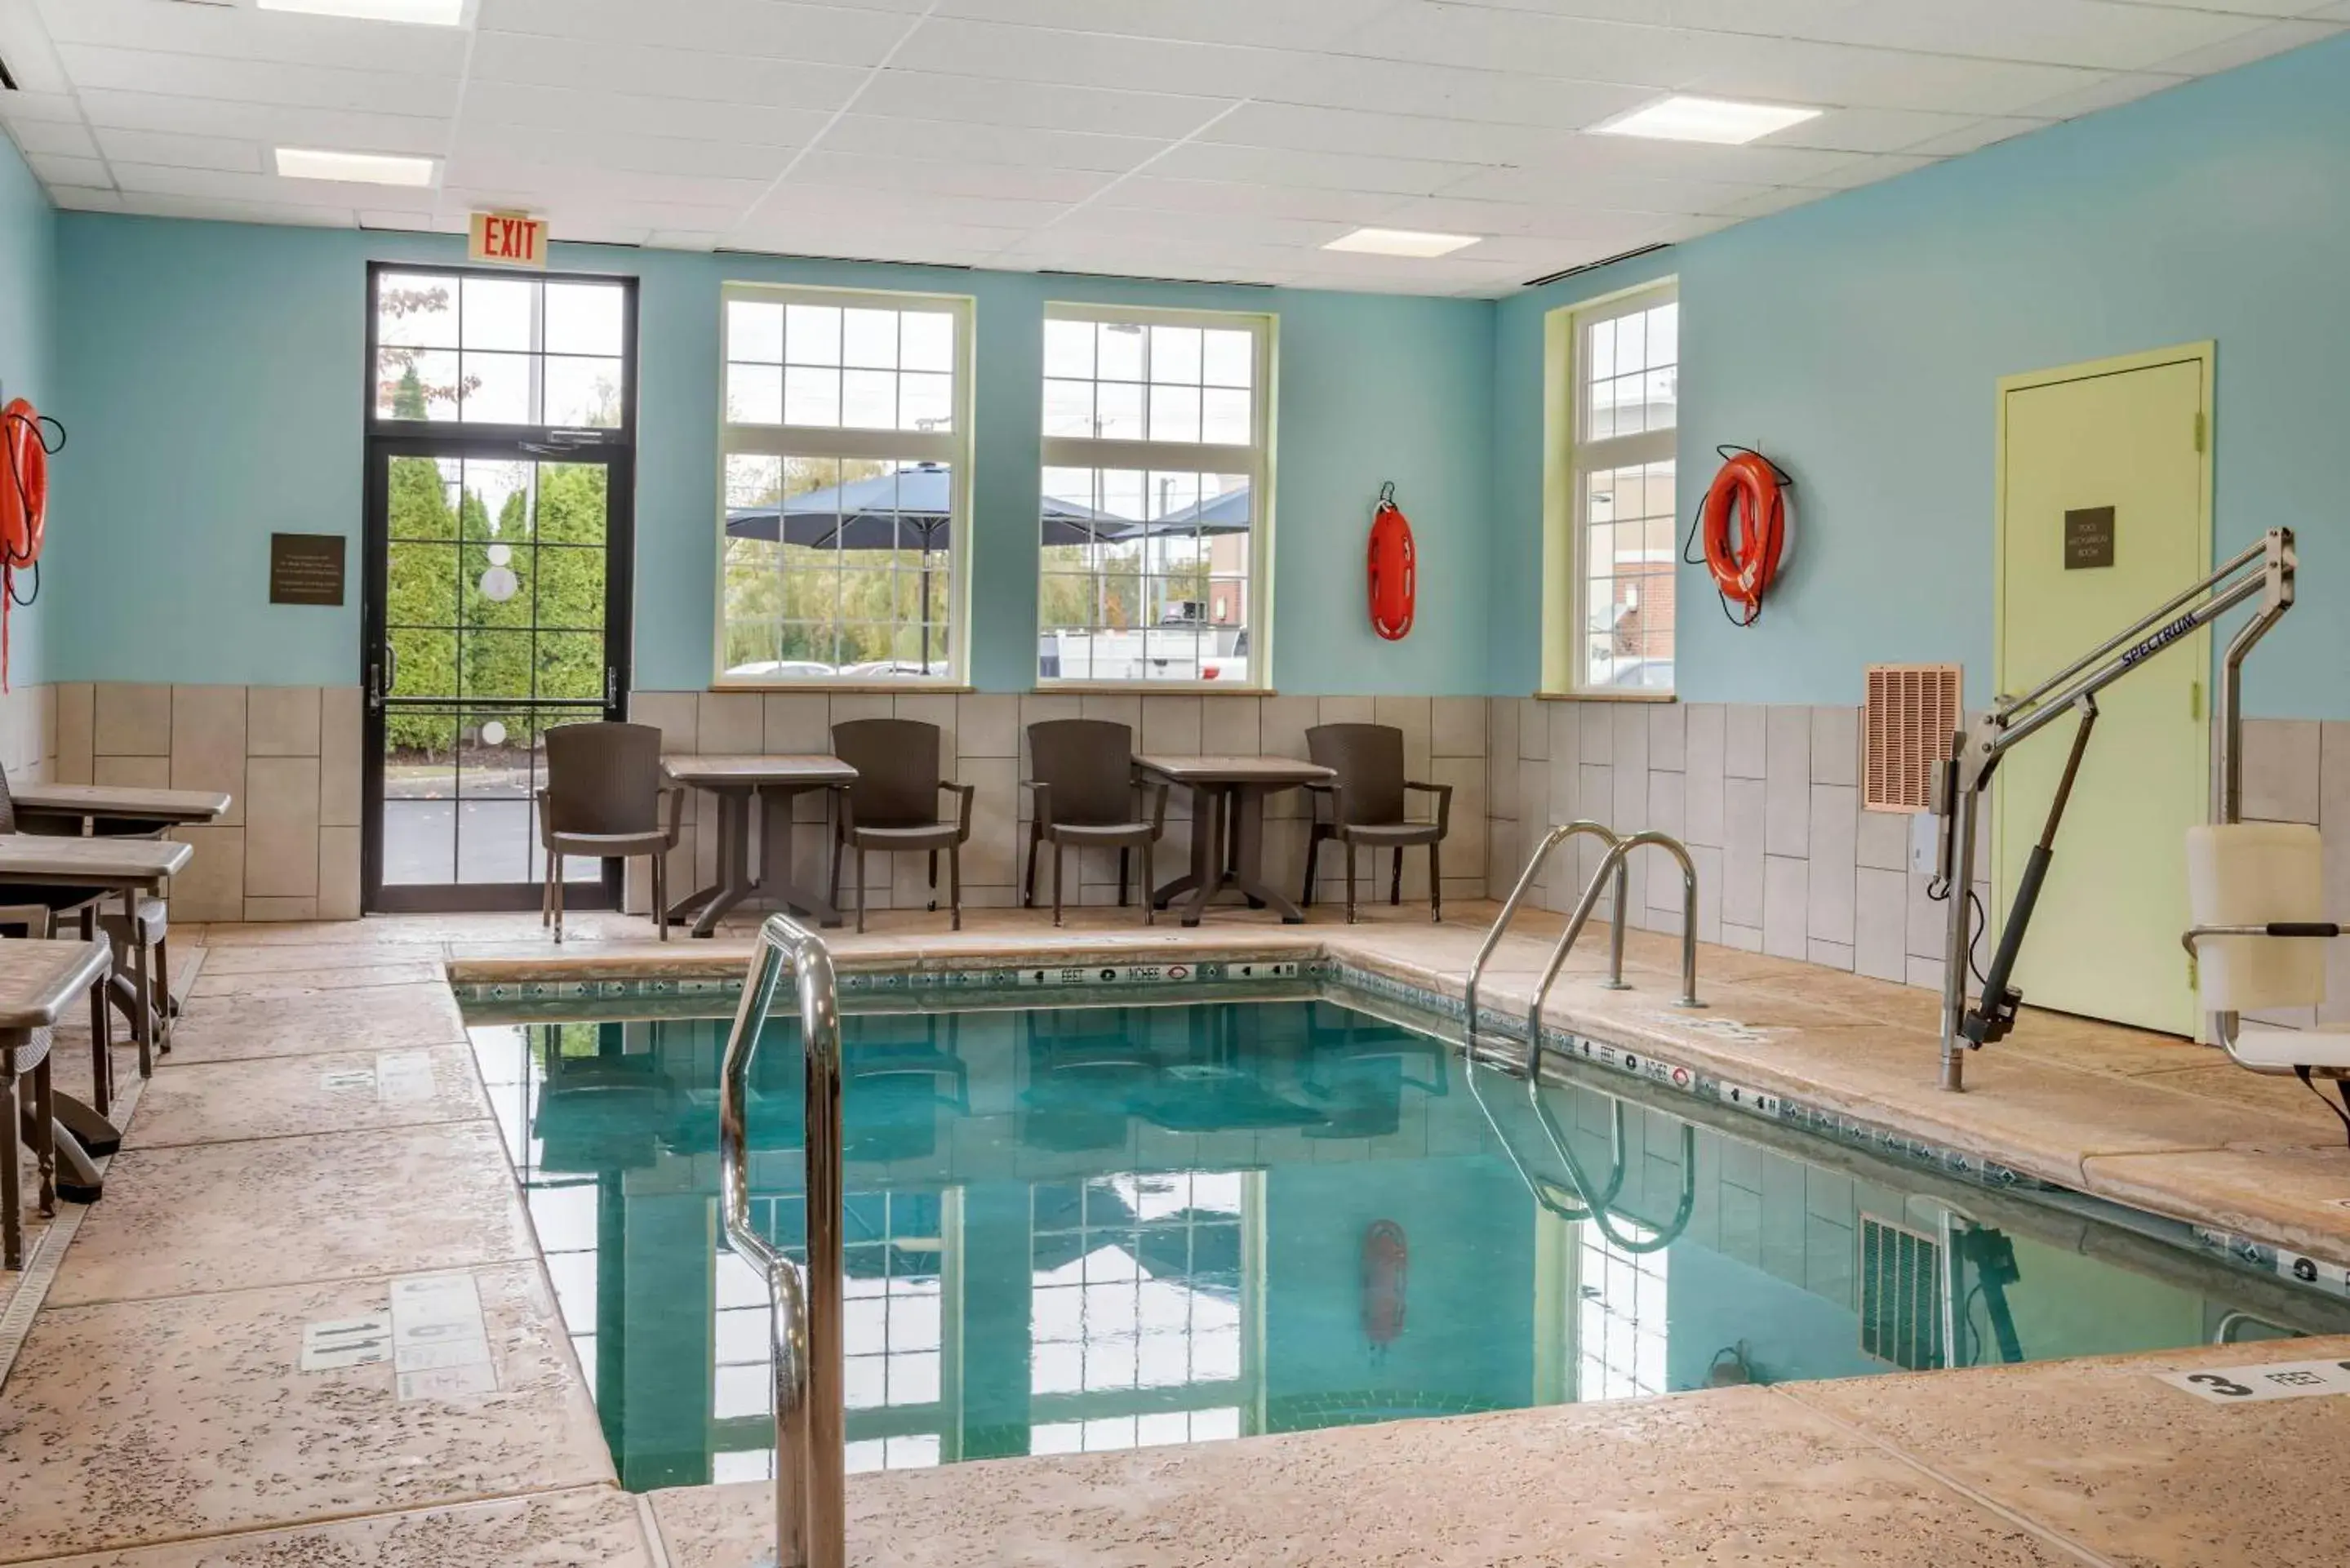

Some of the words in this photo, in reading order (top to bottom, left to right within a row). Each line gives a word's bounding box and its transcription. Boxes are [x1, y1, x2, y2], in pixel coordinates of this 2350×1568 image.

[485, 216, 537, 260] EXIT
[2123, 612, 2197, 667] SPECTRUM
[2188, 1374, 2254, 1396] 3
[2264, 1370, 2328, 1387] FEET
